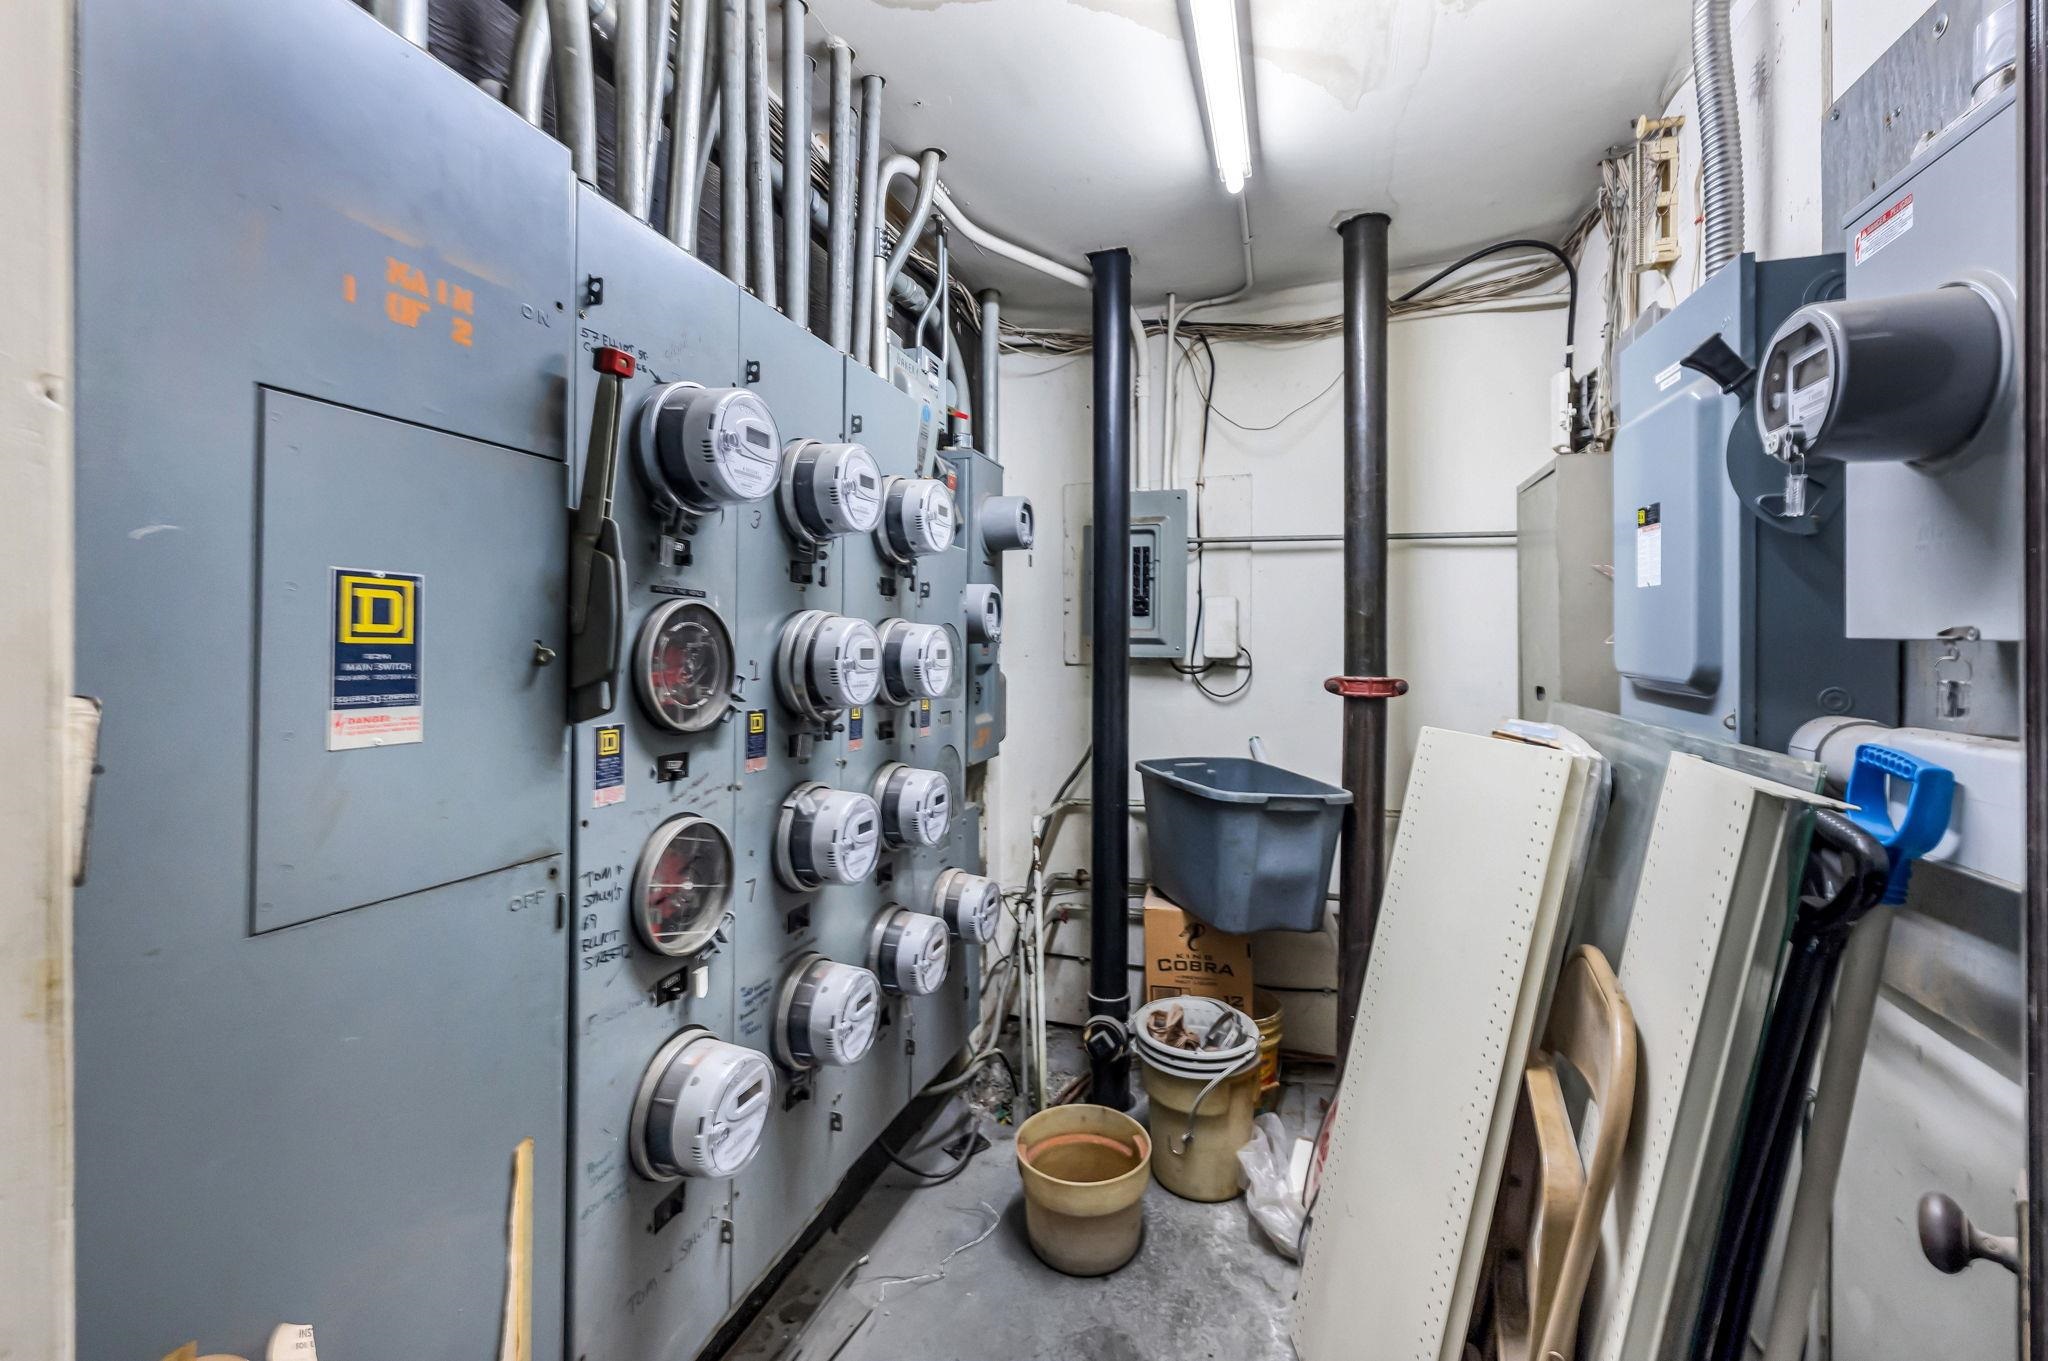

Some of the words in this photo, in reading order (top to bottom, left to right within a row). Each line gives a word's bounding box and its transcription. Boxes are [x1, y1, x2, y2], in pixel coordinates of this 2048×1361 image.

[519, 302, 551, 329] ON
[451, 316, 474, 348] 2
[750, 510, 762, 530] 3
[341, 662, 374, 671] MAIN
[375, 662, 412, 671] SWITCH
[511, 889, 547, 912] OFF
[1157, 958, 1235, 977] COBRA
